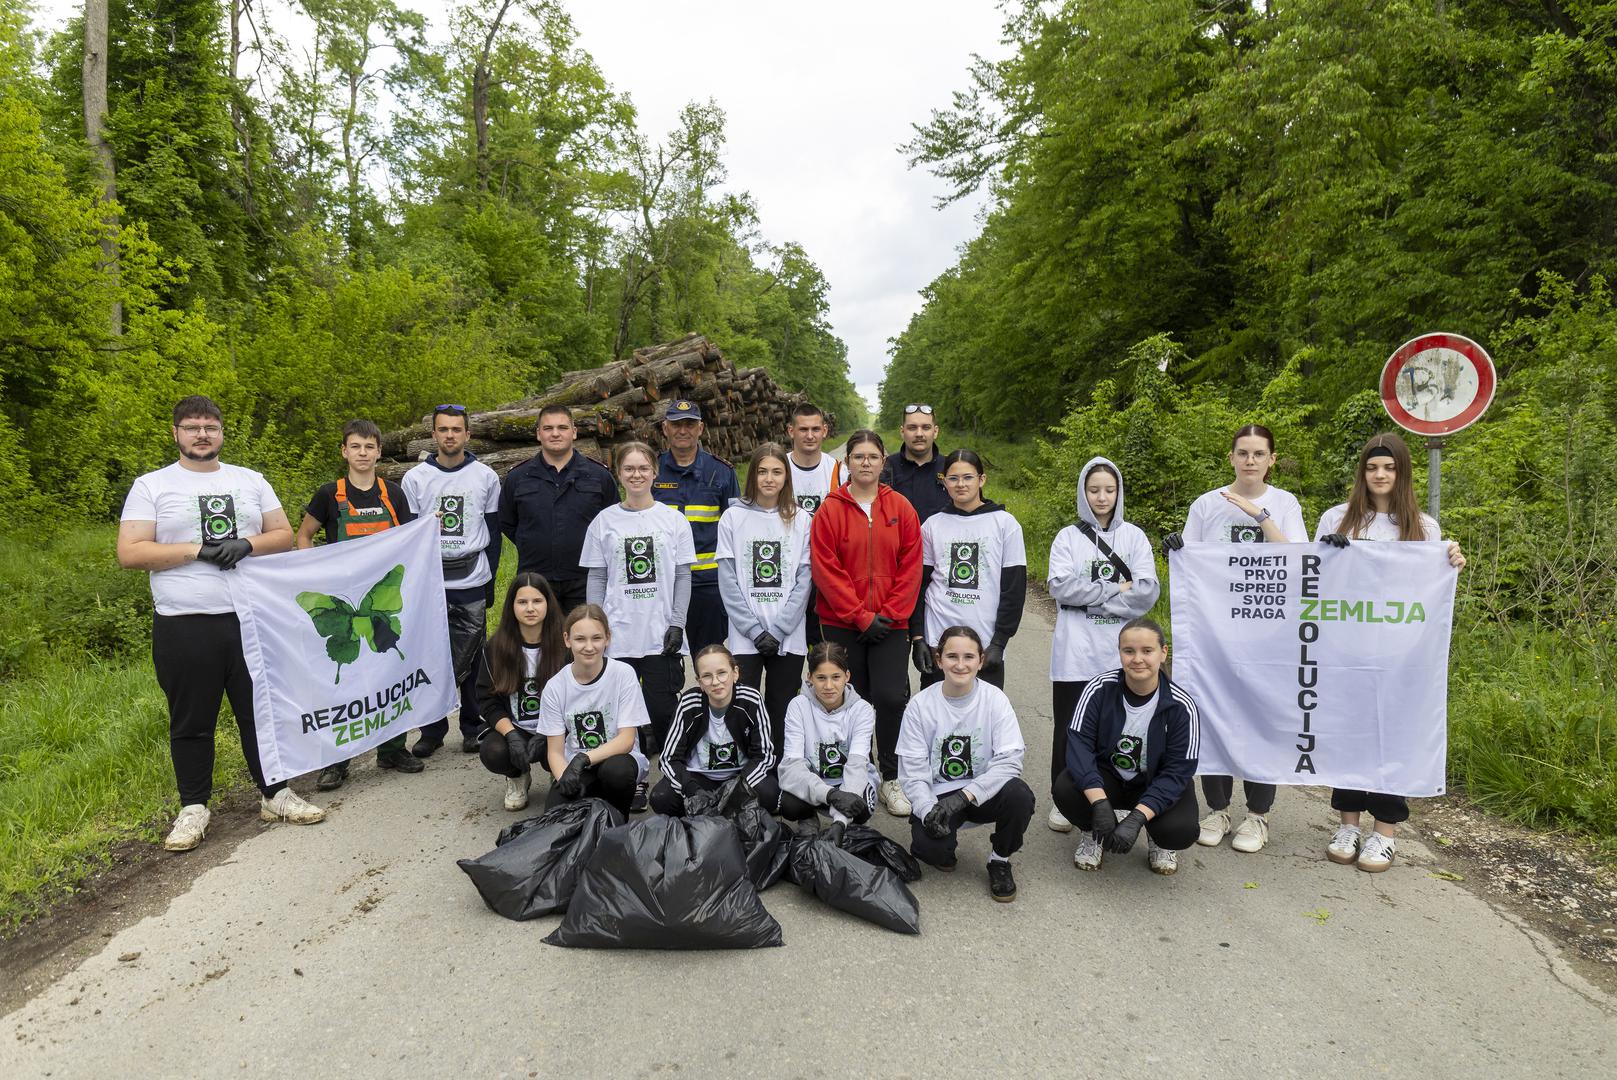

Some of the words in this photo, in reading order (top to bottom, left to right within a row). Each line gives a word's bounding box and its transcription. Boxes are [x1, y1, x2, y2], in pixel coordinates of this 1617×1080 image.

[1228, 556, 1287, 567] POMETI
[1244, 569, 1288, 581] PRVO
[1229, 582, 1287, 594] ISPRED
[1242, 594, 1286, 606] SVOG
[1231, 607, 1287, 620] PRAGA
[1299, 599, 1426, 625] ZEMLJA
[1294, 554, 1322, 775] REZOLUCIJA
[301, 668, 432, 734] REZOLUCIJA
[332, 696, 413, 747] ZEMLJA
